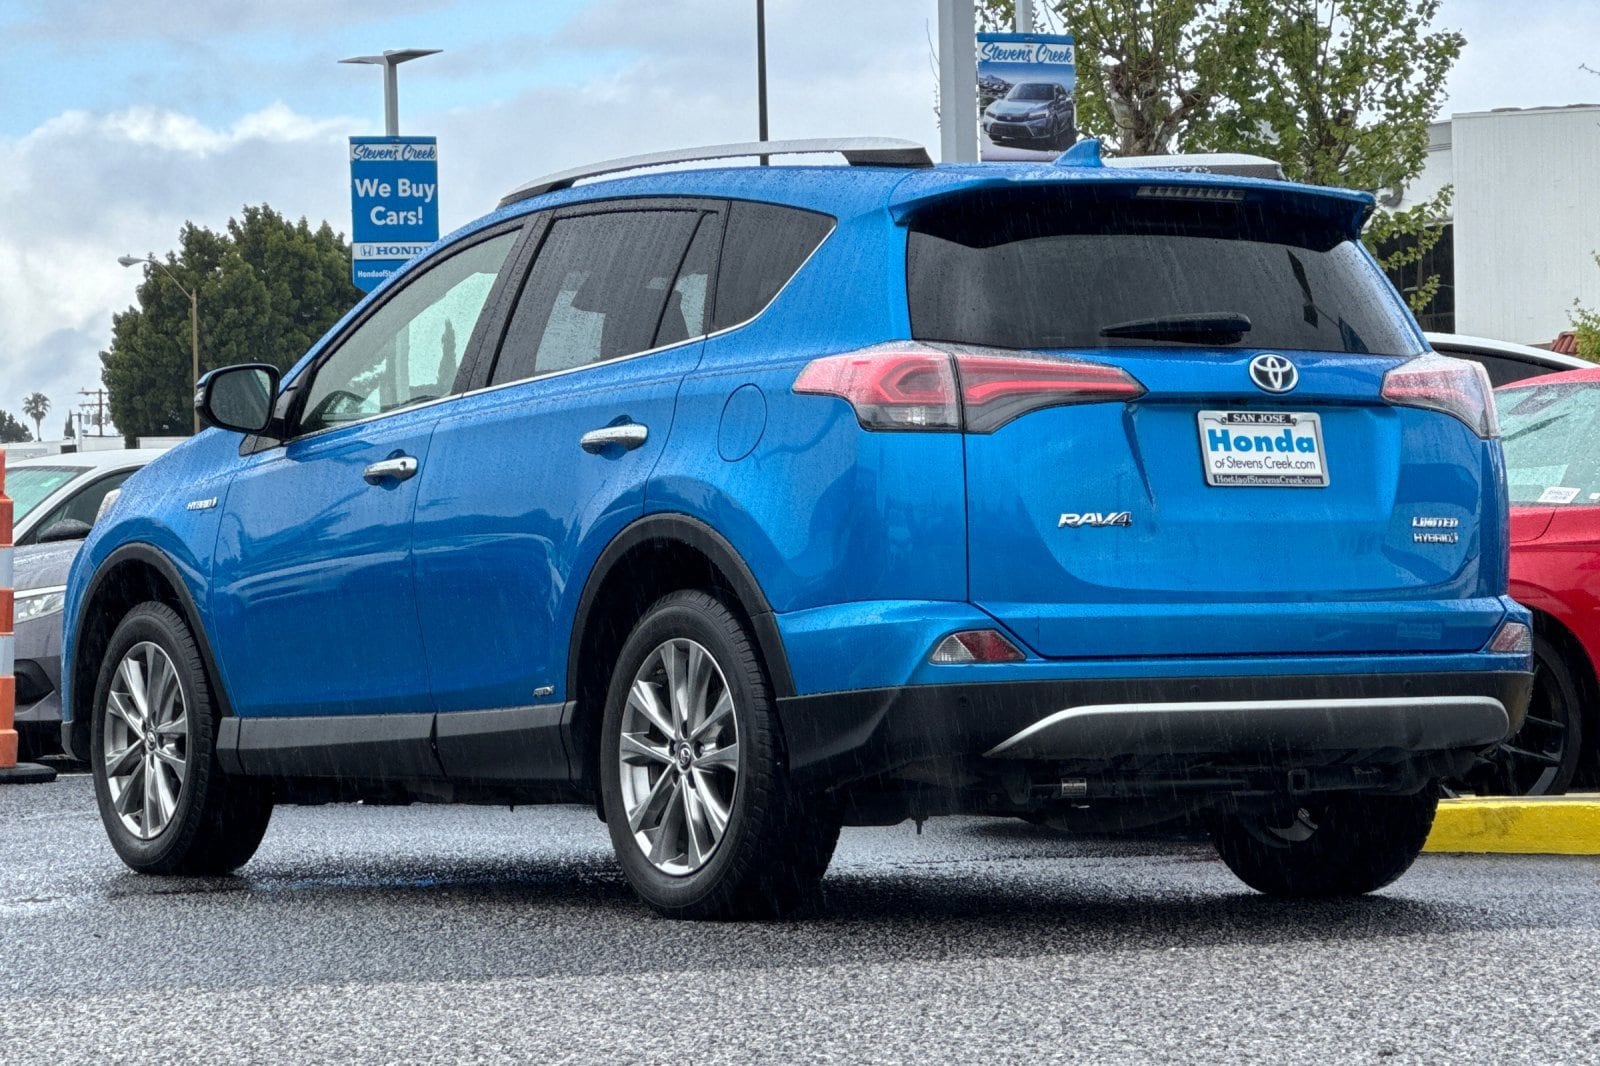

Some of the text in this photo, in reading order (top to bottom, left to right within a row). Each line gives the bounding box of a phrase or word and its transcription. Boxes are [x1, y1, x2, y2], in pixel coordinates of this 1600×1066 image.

[980, 42, 1072, 63] Stevens Creek
[352, 144, 436, 160] Stevens Creek
[354, 178, 435, 203] We Buy
[370, 206, 424, 226] Cars!
[375, 245, 430, 256] HOND
[1233, 413, 1286, 423] SAN JOSE
[1207, 428, 1316, 453] Honda
[1214, 455, 1316, 470] of Stevens Creek.com
[1057, 511, 1133, 528] RAV4
